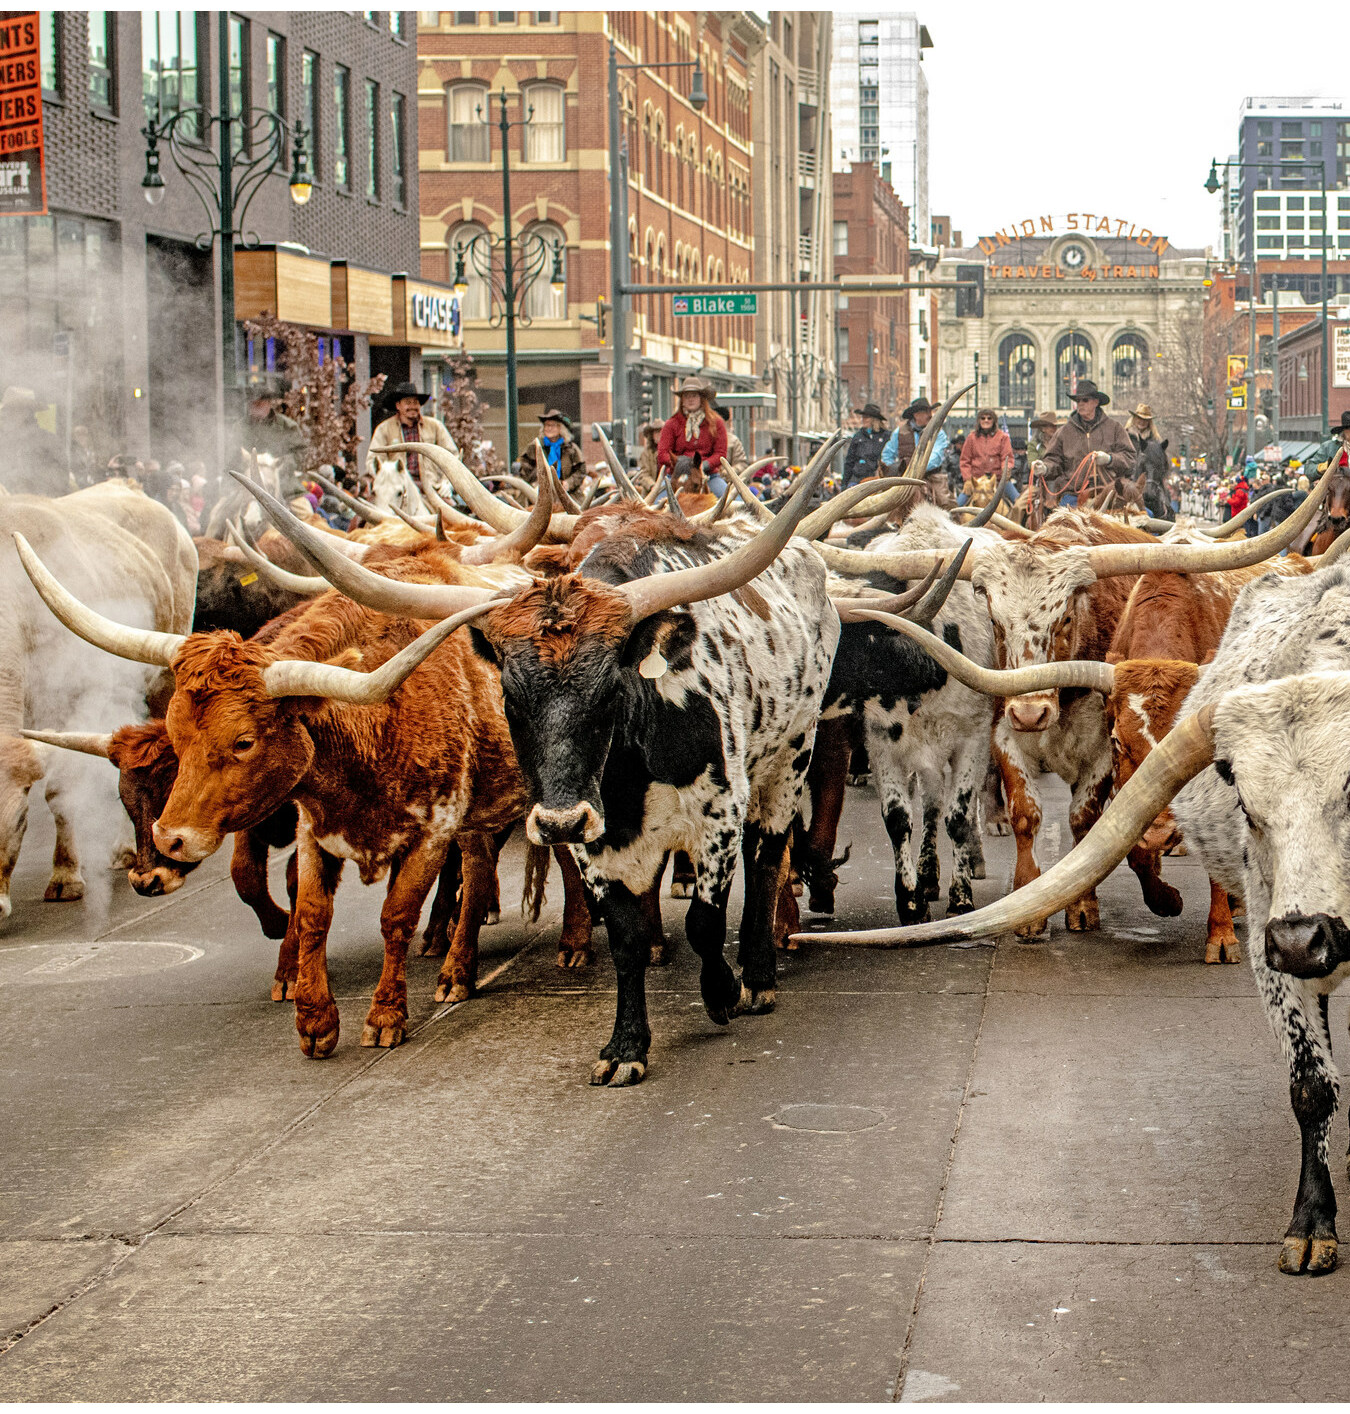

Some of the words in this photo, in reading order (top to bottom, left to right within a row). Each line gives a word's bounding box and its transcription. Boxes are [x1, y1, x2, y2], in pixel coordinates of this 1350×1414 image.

[0, 95, 36, 120] ERS
[1, 129, 39, 150] FOOLS
[978, 214, 1053, 256] UNION
[1066, 213, 1169, 256] STATION
[989, 265, 1064, 278] TRAVEL
[1080, 265, 1097, 282] by
[1100, 265, 1158, 278] TRAIN
[412, 293, 454, 331] CHASE
[693, 297, 735, 313] Blake
